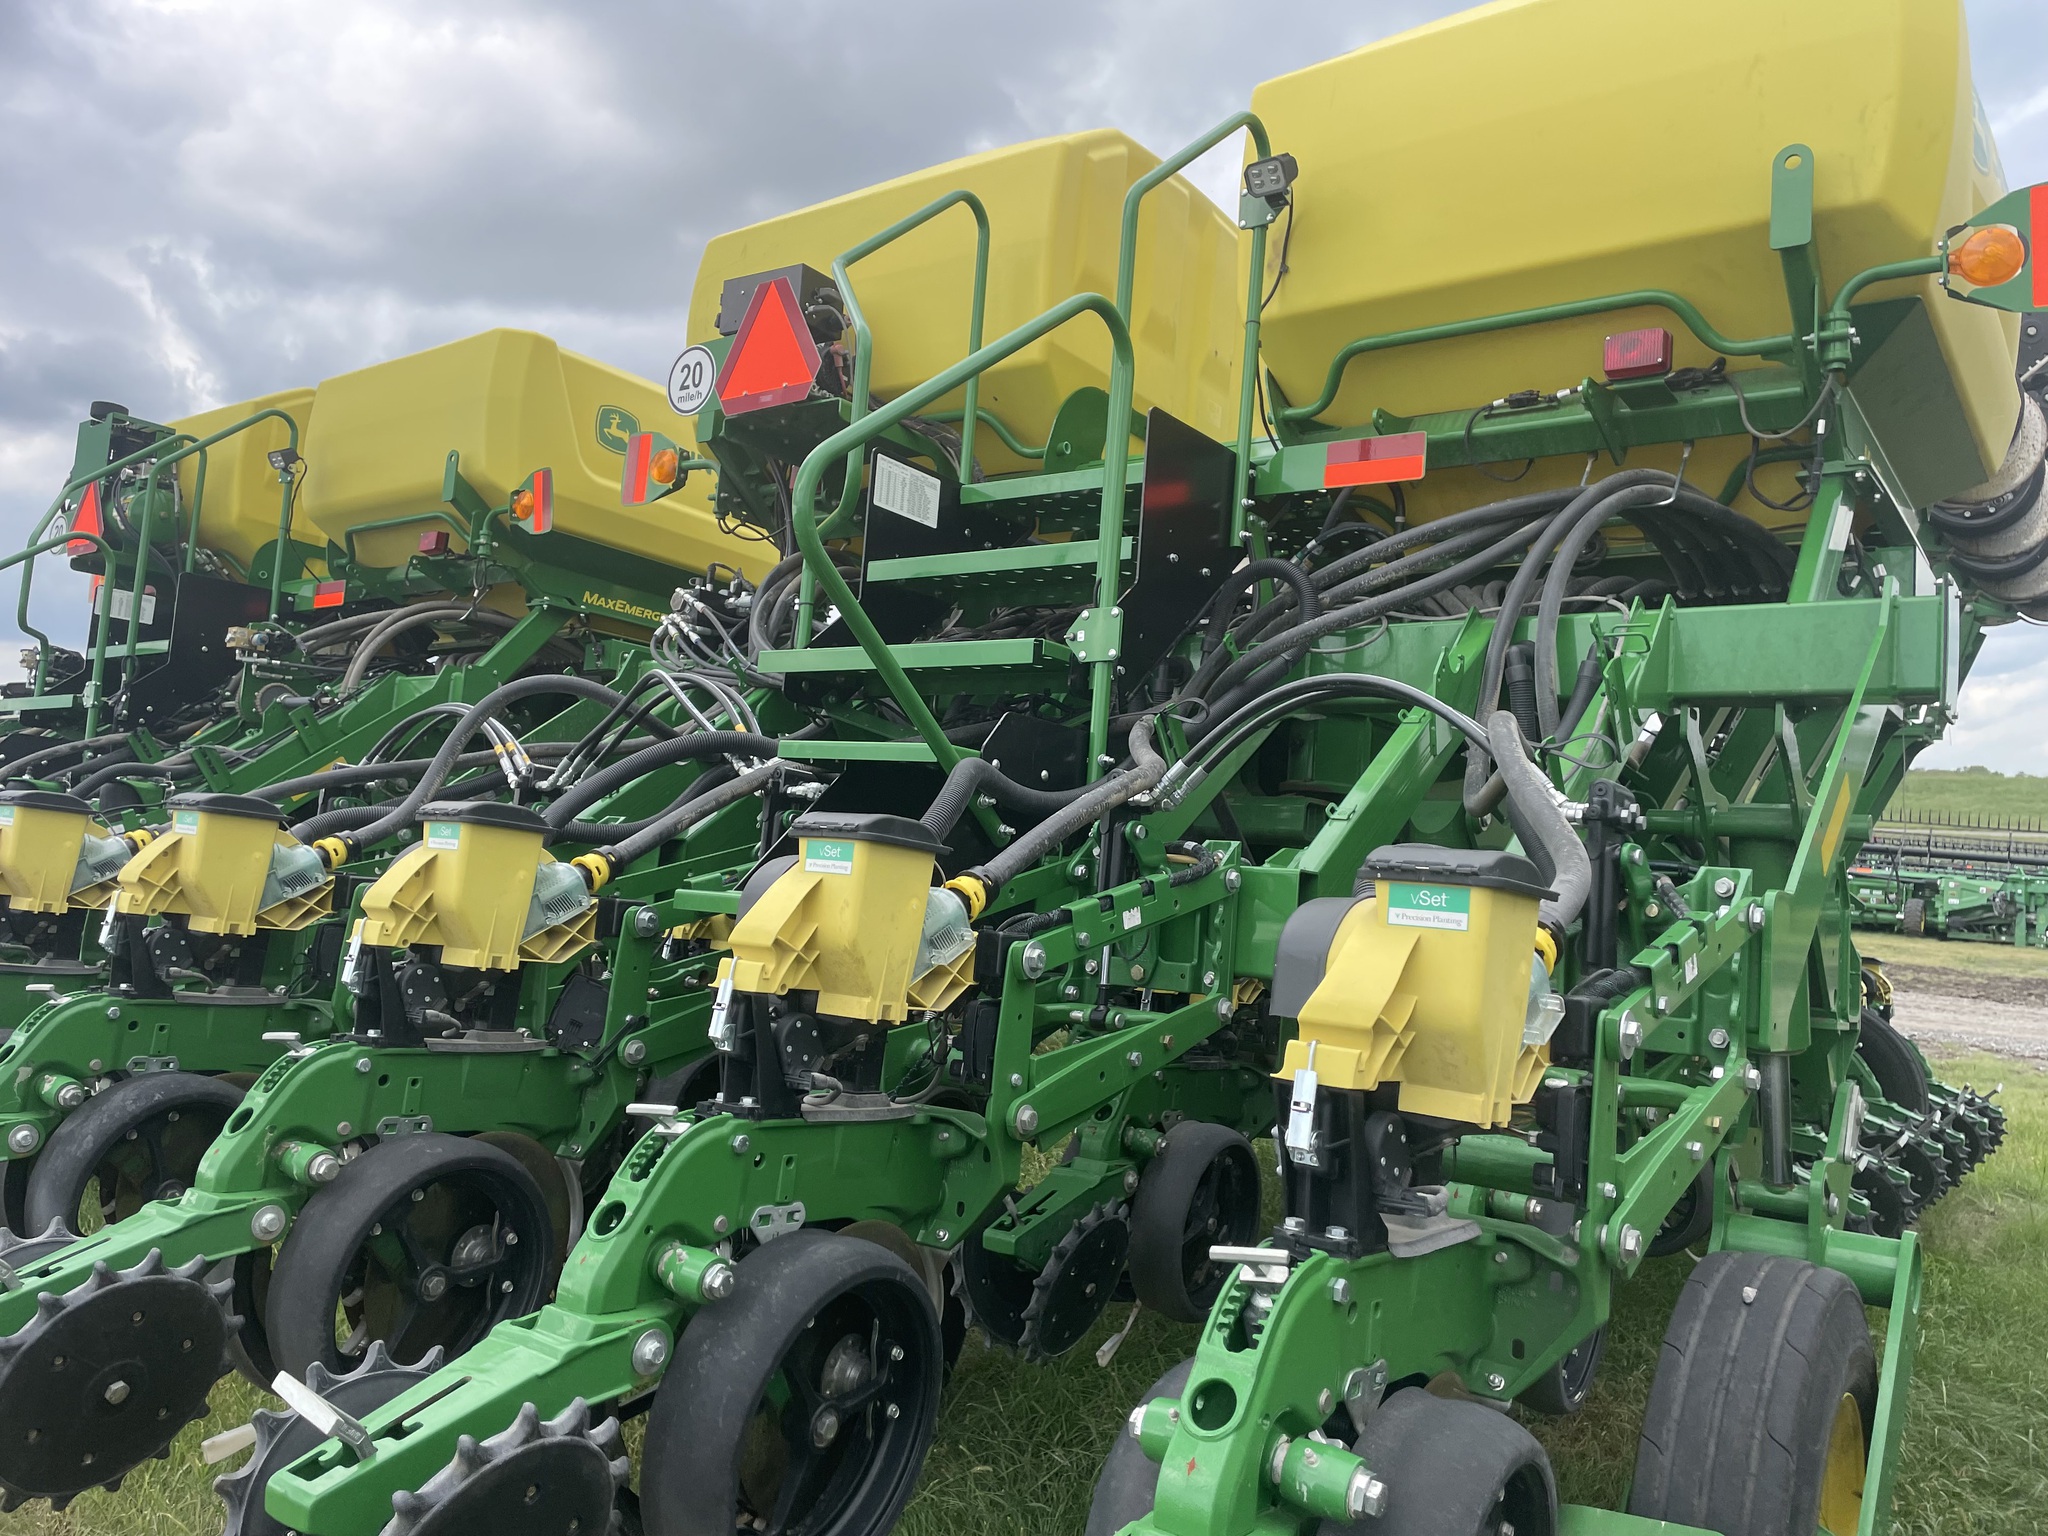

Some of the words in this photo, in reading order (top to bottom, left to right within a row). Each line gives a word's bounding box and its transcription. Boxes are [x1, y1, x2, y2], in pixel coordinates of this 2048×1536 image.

[678, 361, 703, 391] 20
[677, 390, 703, 404] mile/h
[819, 844, 841, 858] vSet
[1410, 890, 1447, 907] vSet
[1401, 912, 1432, 922] Precision
[1432, 915, 1463, 927] Planting
